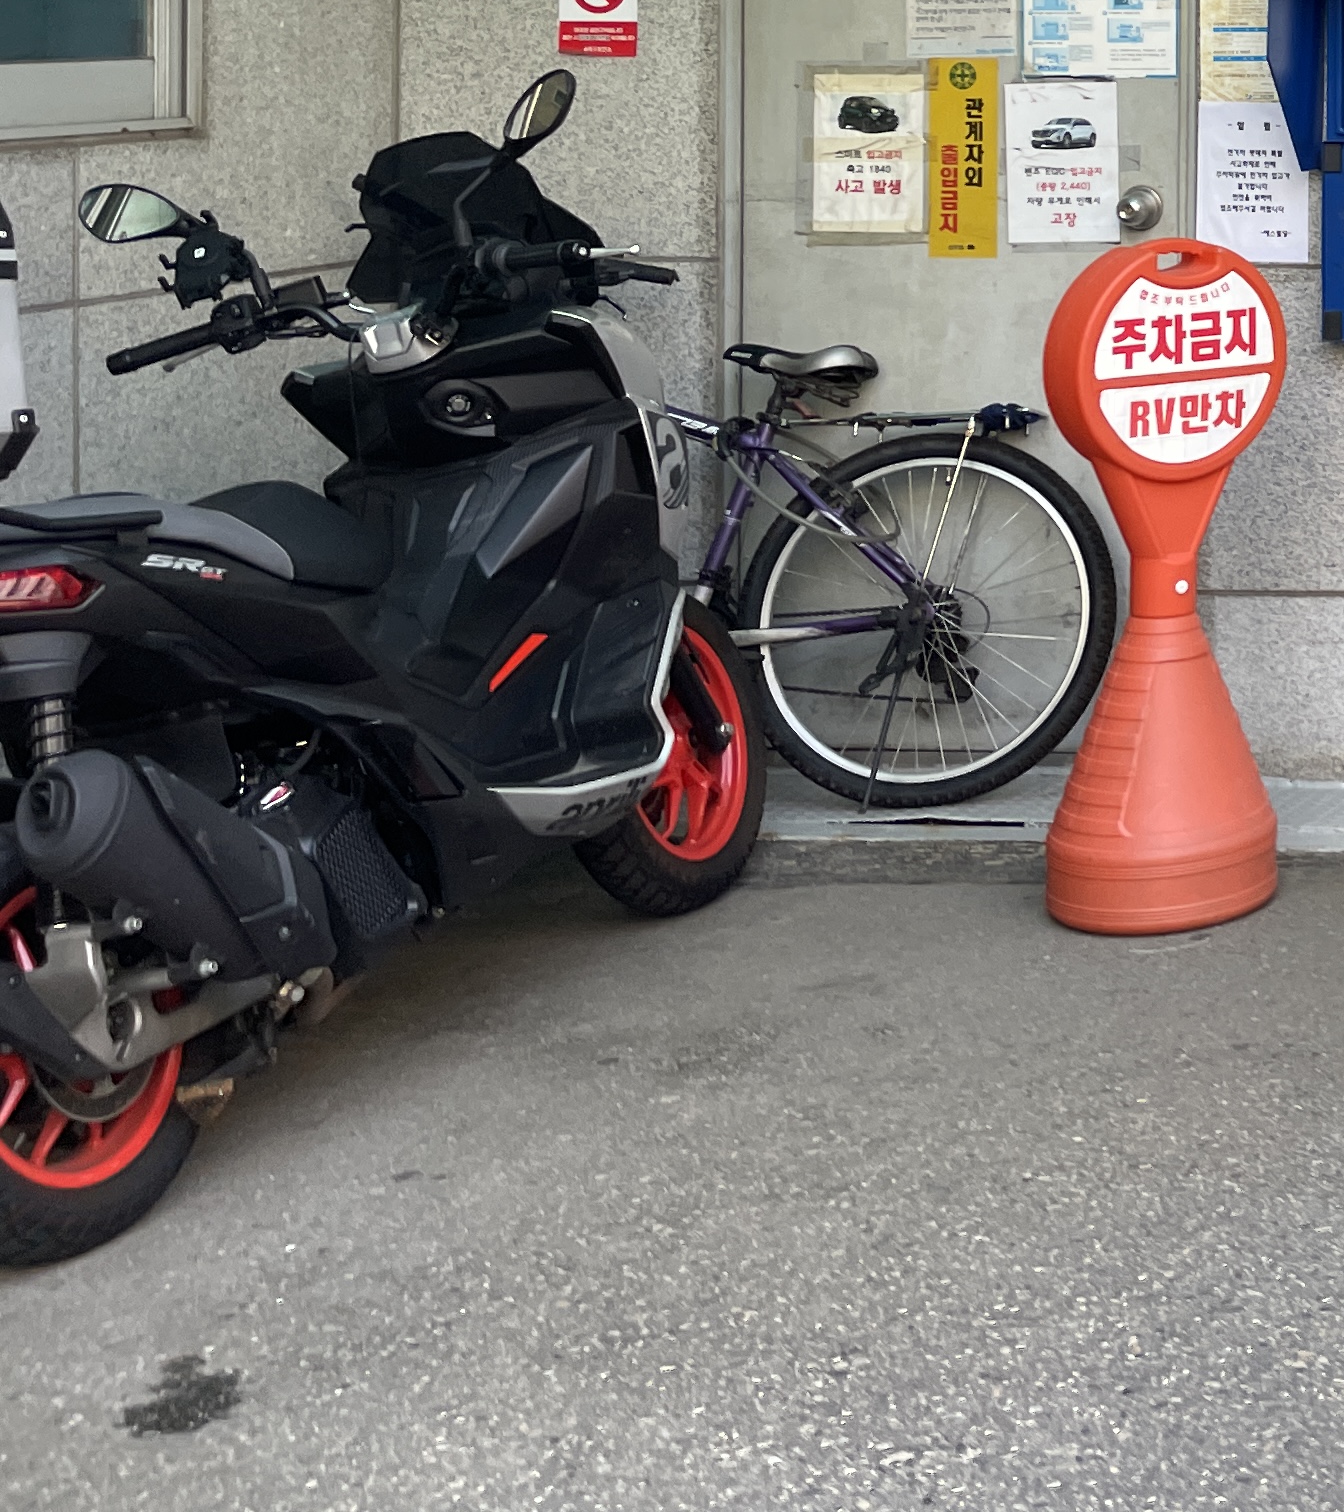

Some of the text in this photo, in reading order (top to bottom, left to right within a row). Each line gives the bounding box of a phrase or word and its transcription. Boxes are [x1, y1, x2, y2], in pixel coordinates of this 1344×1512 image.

[964, 97, 985, 188] 관계자외
[835, 179, 901, 195] 사고 발생
[939, 144, 959, 234] 출입금지
[1050, 212, 1077, 227] 고장
[1112, 306, 1257, 370] 주차금지
[1129, 389, 1246, 438] RV만차
[140, 553, 207, 572] SR
